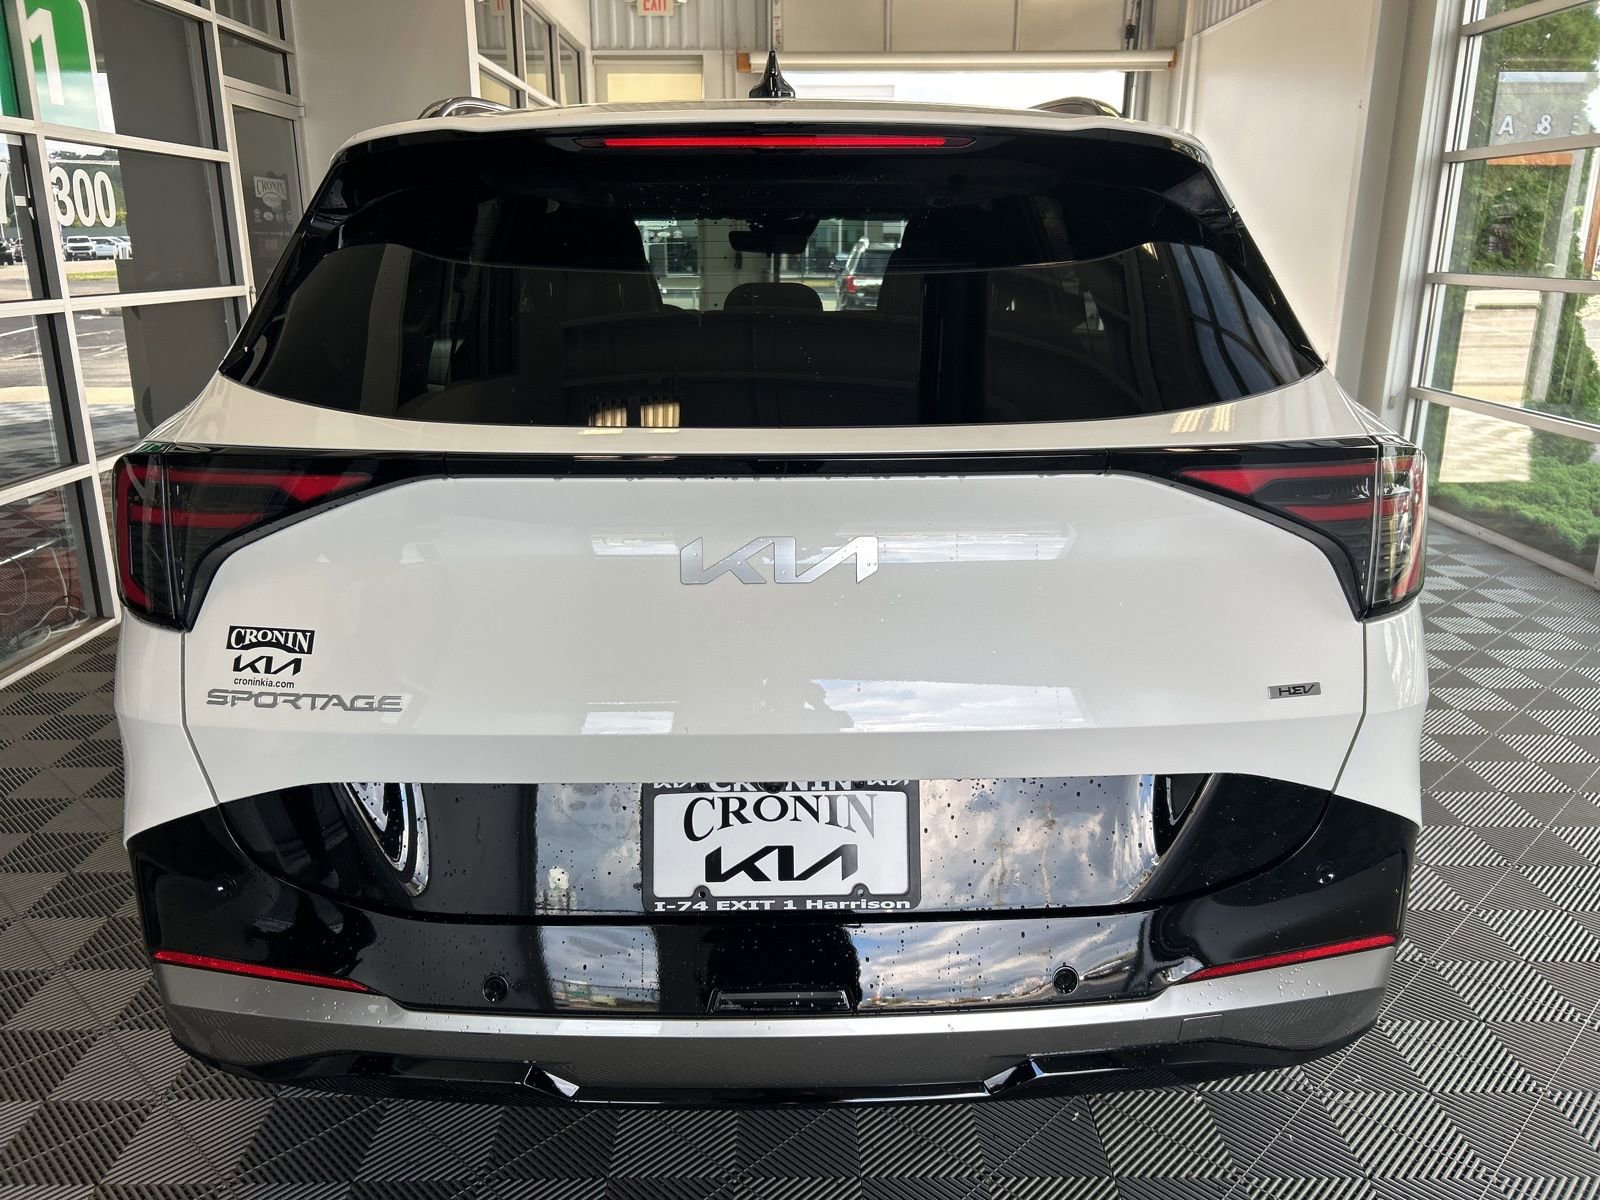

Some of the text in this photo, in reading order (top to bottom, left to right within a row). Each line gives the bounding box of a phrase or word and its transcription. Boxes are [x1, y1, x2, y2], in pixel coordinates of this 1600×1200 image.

[256, 178, 286, 199] CRONIN
[680, 536, 879, 585] KIA
[230, 627, 312, 654] CRONIN
[232, 654, 302, 676] KIA
[233, 677, 295, 689] croninkia.com
[1278, 684, 1315, 697] HEV
[206, 688, 404, 713] SPORTAGE
[683, 793, 879, 842] CRONIN
[705, 843, 858, 883] KIA
[654, 898, 911, 912] I-74 EXIT 1 Harrison
